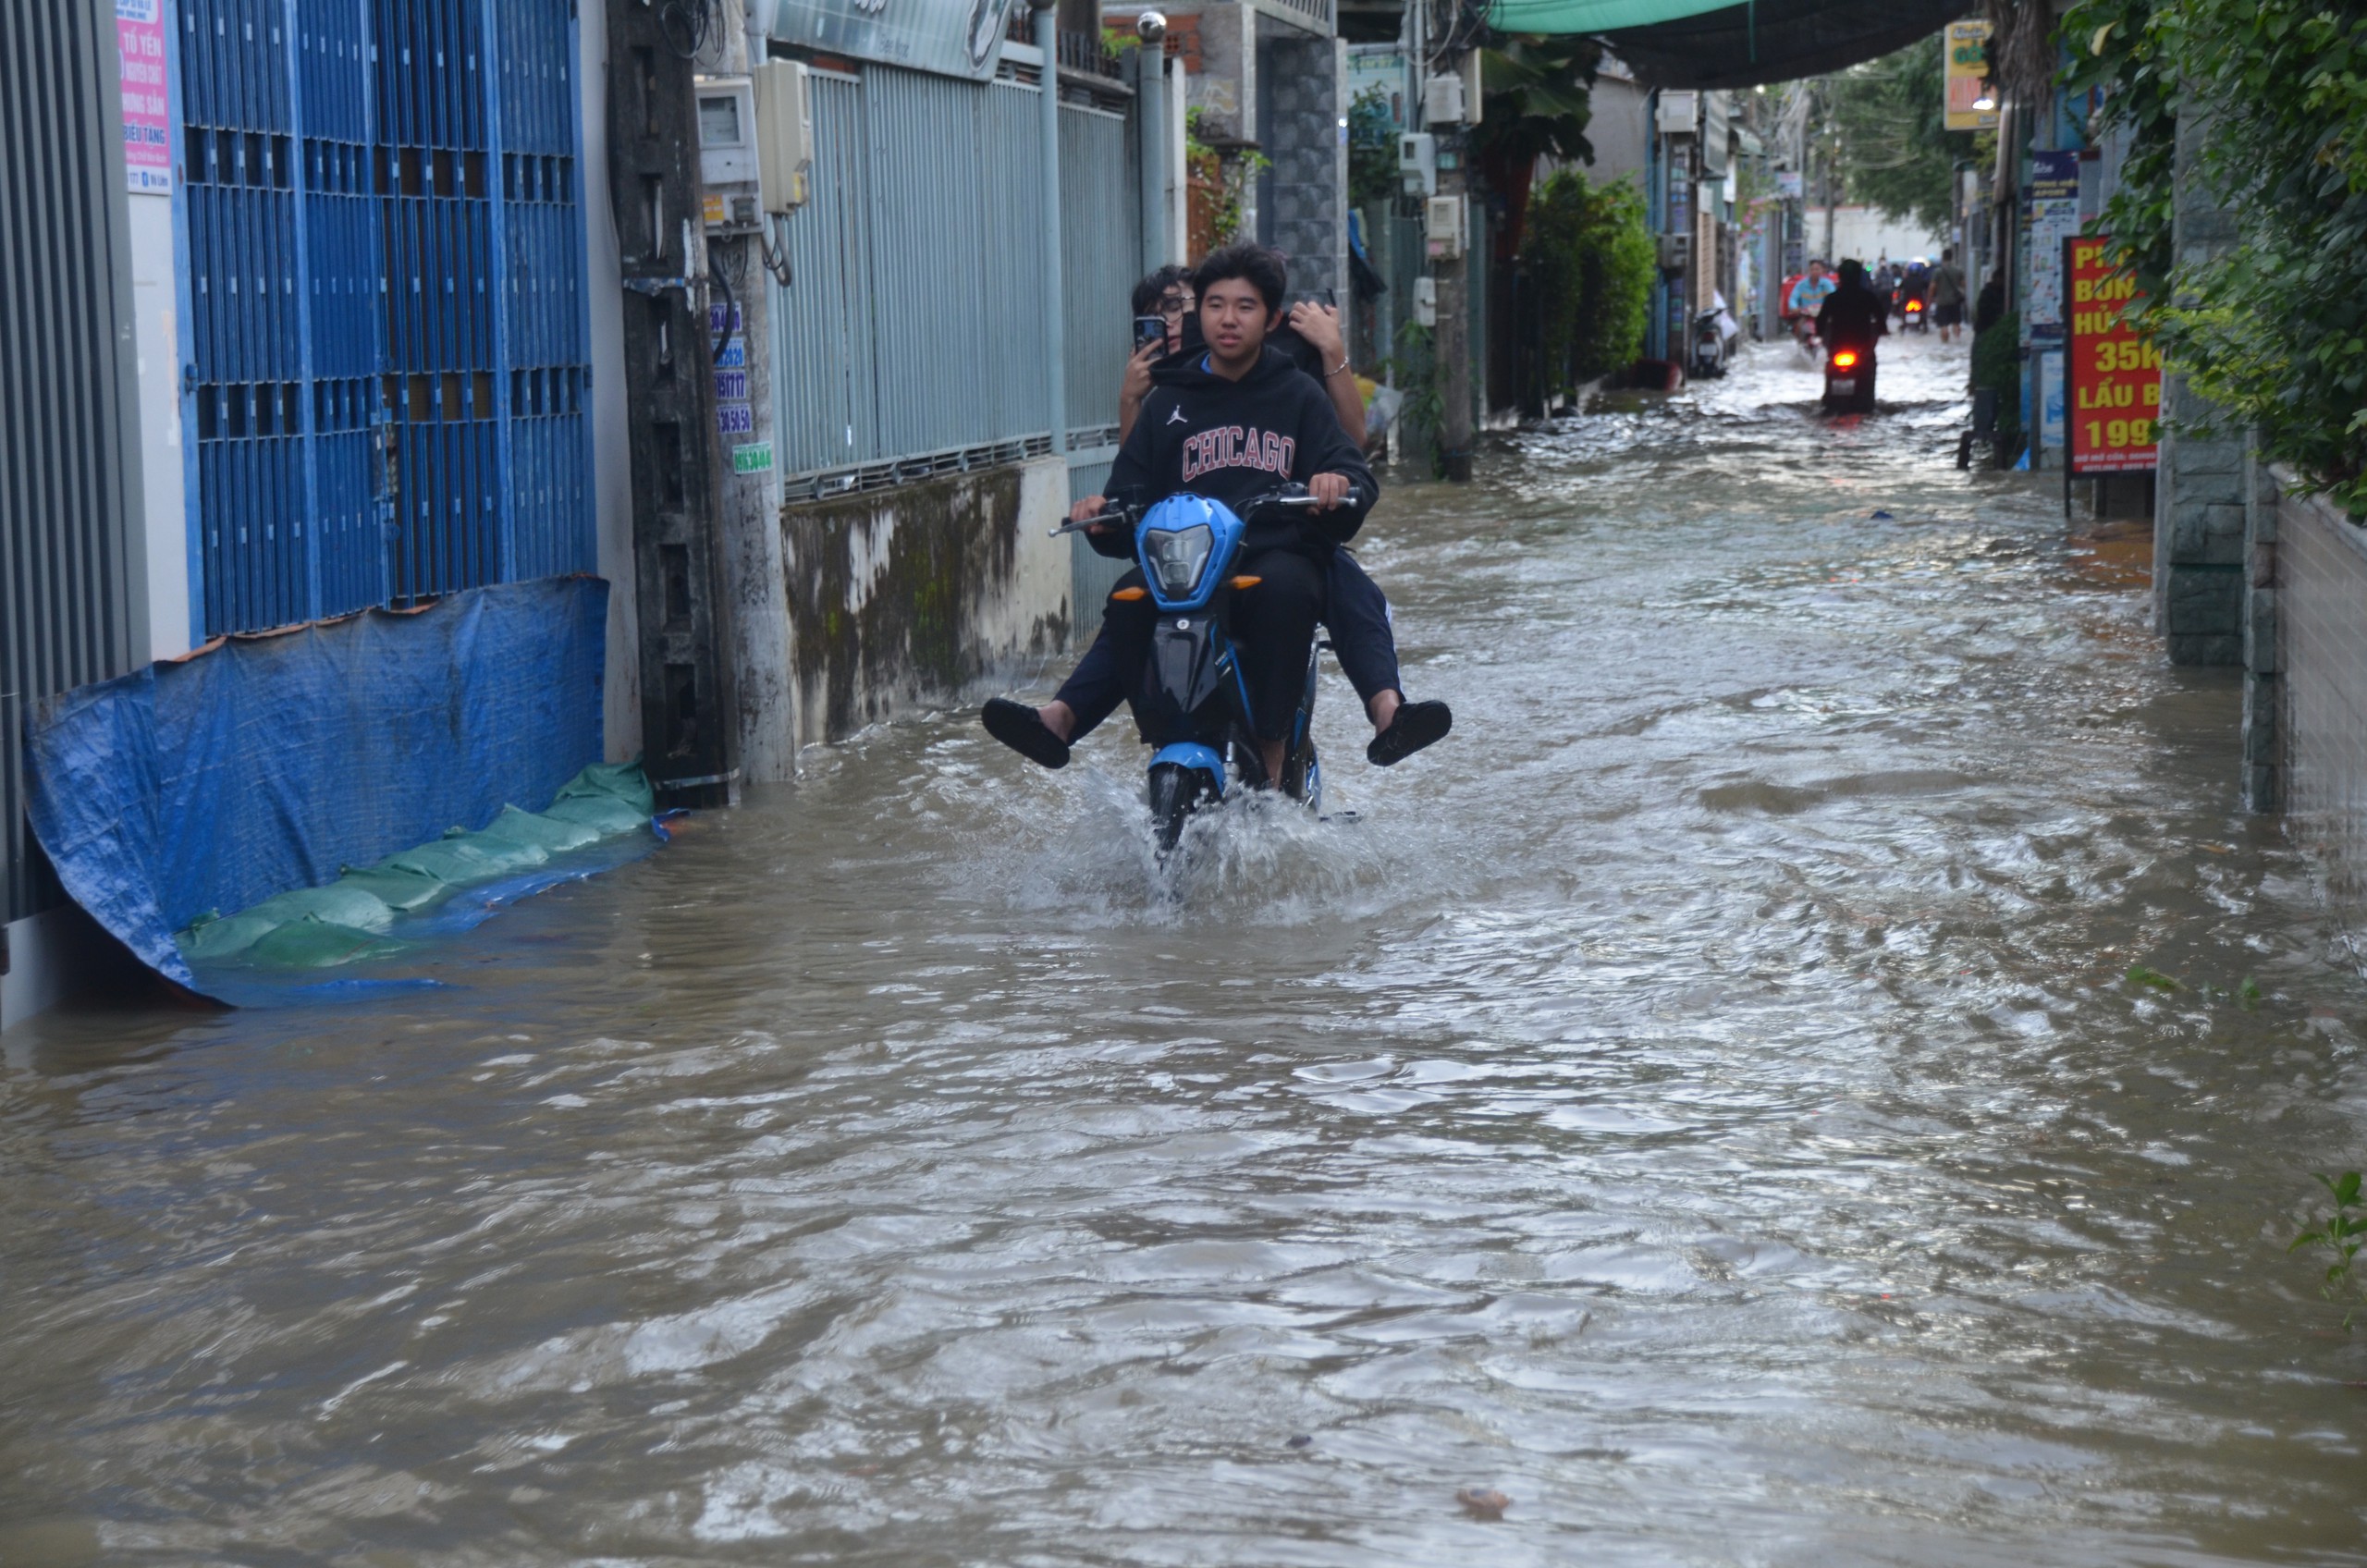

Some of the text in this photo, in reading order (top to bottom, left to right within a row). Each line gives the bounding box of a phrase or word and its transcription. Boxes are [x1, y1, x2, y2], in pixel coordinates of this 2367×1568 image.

[140, 30, 162, 57] YẾN
[2084, 418, 2150, 448] 199
[1183, 425, 1295, 483] CHICAGO
